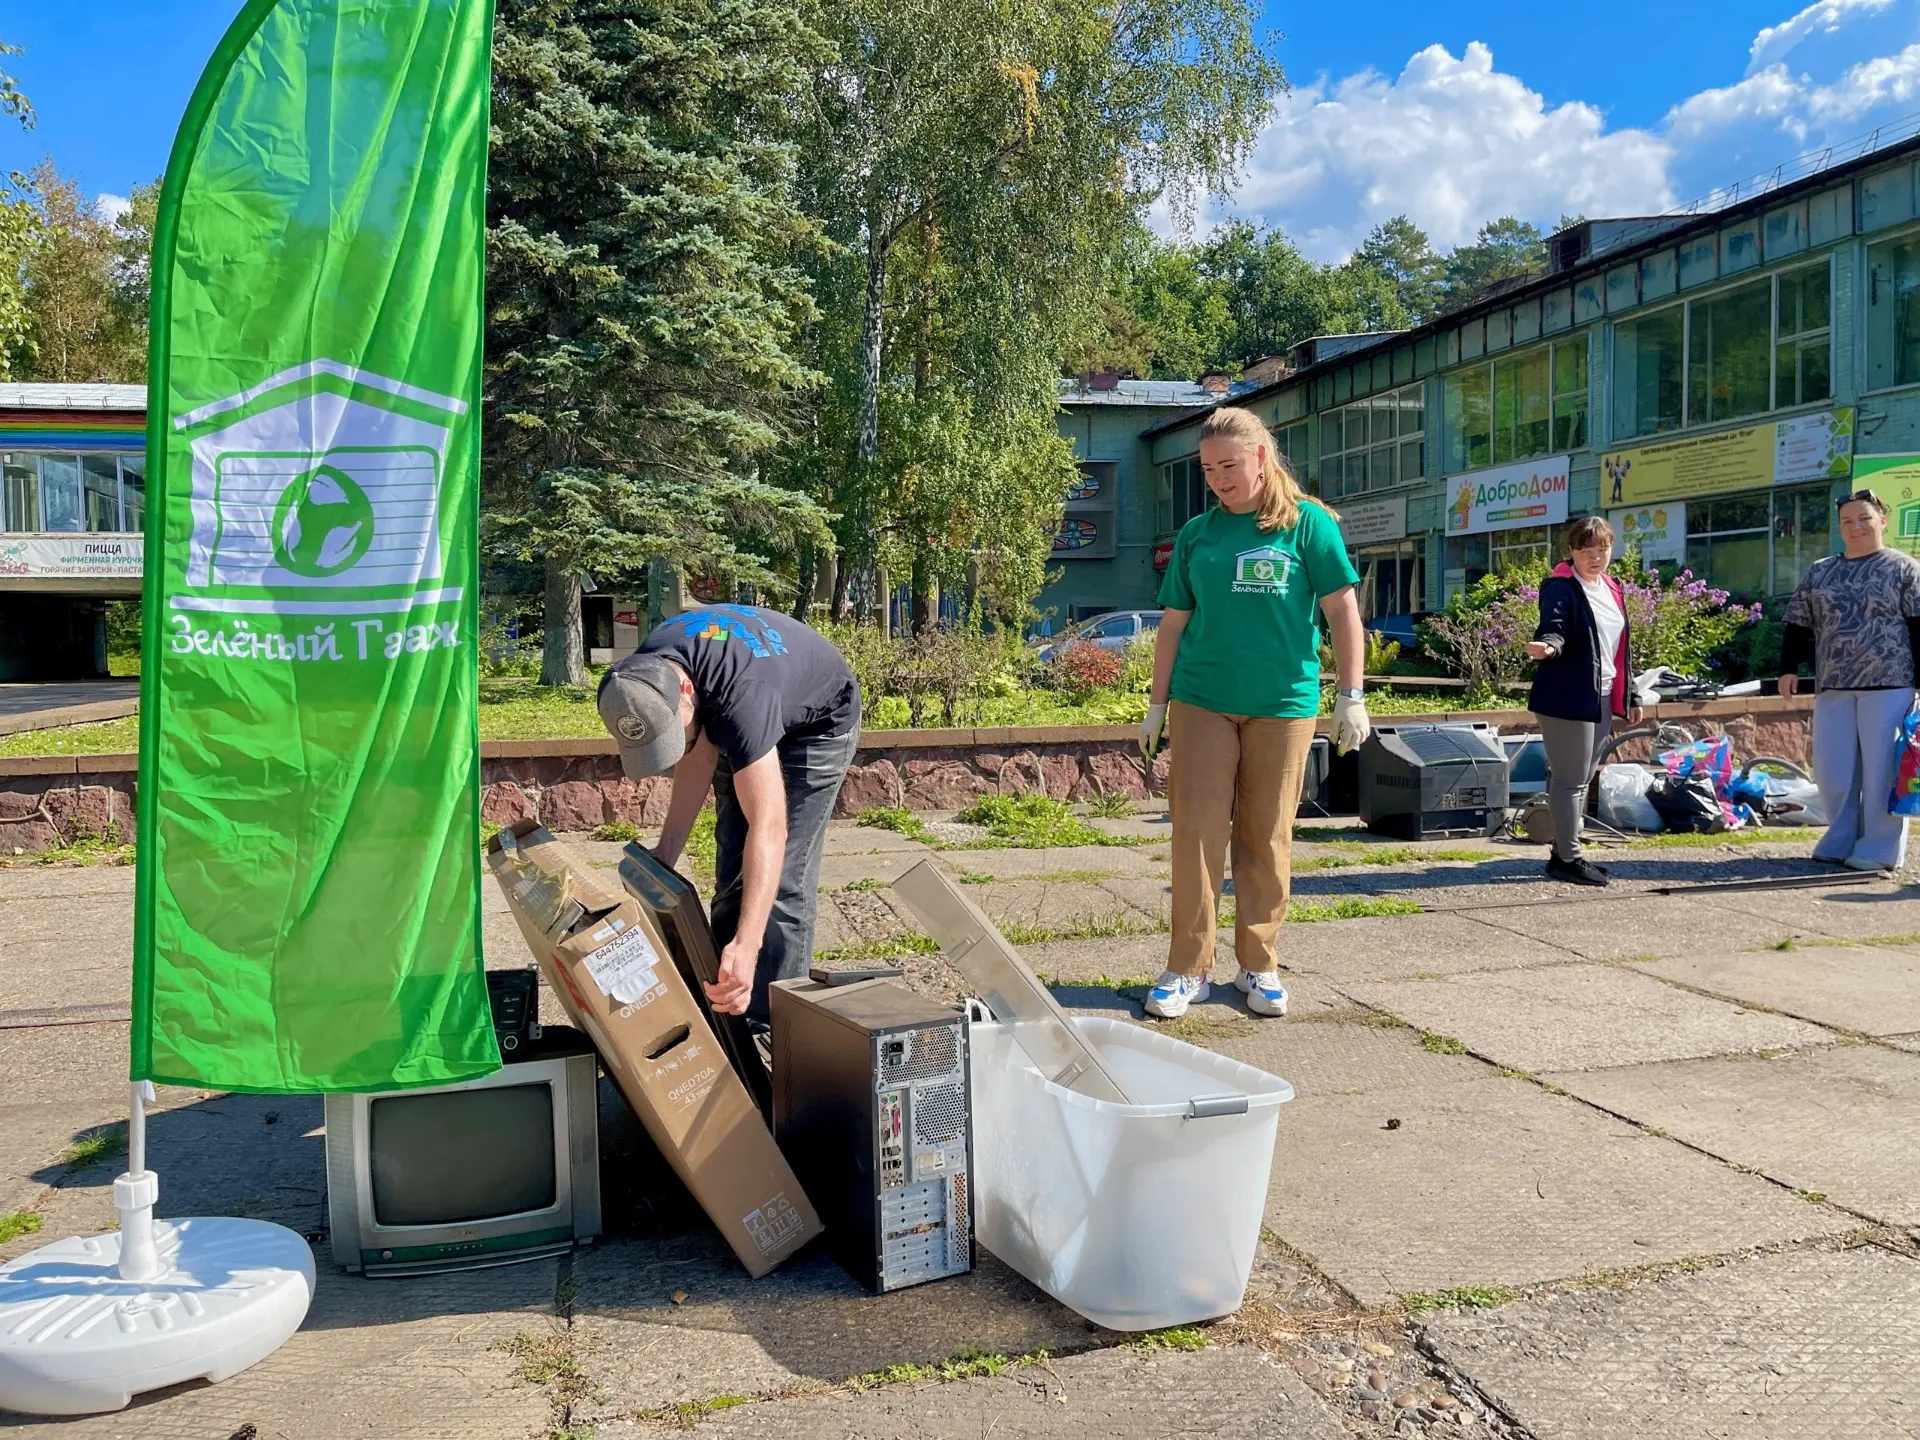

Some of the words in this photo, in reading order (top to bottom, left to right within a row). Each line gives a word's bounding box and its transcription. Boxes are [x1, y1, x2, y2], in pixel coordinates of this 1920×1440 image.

[1475, 474, 1566, 508] ДоброДом
[60, 556, 110, 564] ФИРМЕННАЯ
[112, 556, 143, 564] КУРОЧК
[85, 544, 122, 555] ПИЦЦА
[40, 566, 78, 574] ГОРЯЧИЕ
[78, 566, 112, 574] ЗАКУСКИ
[117, 566, 143, 574] ПАСТА
[171, 614, 343, 661] Зелёный
[350, 619, 462, 661] Гааж
[595, 928, 639, 960] 644752394
[620, 992, 655, 1018] QNED
[668, 1067, 716, 1101] QNED70A
